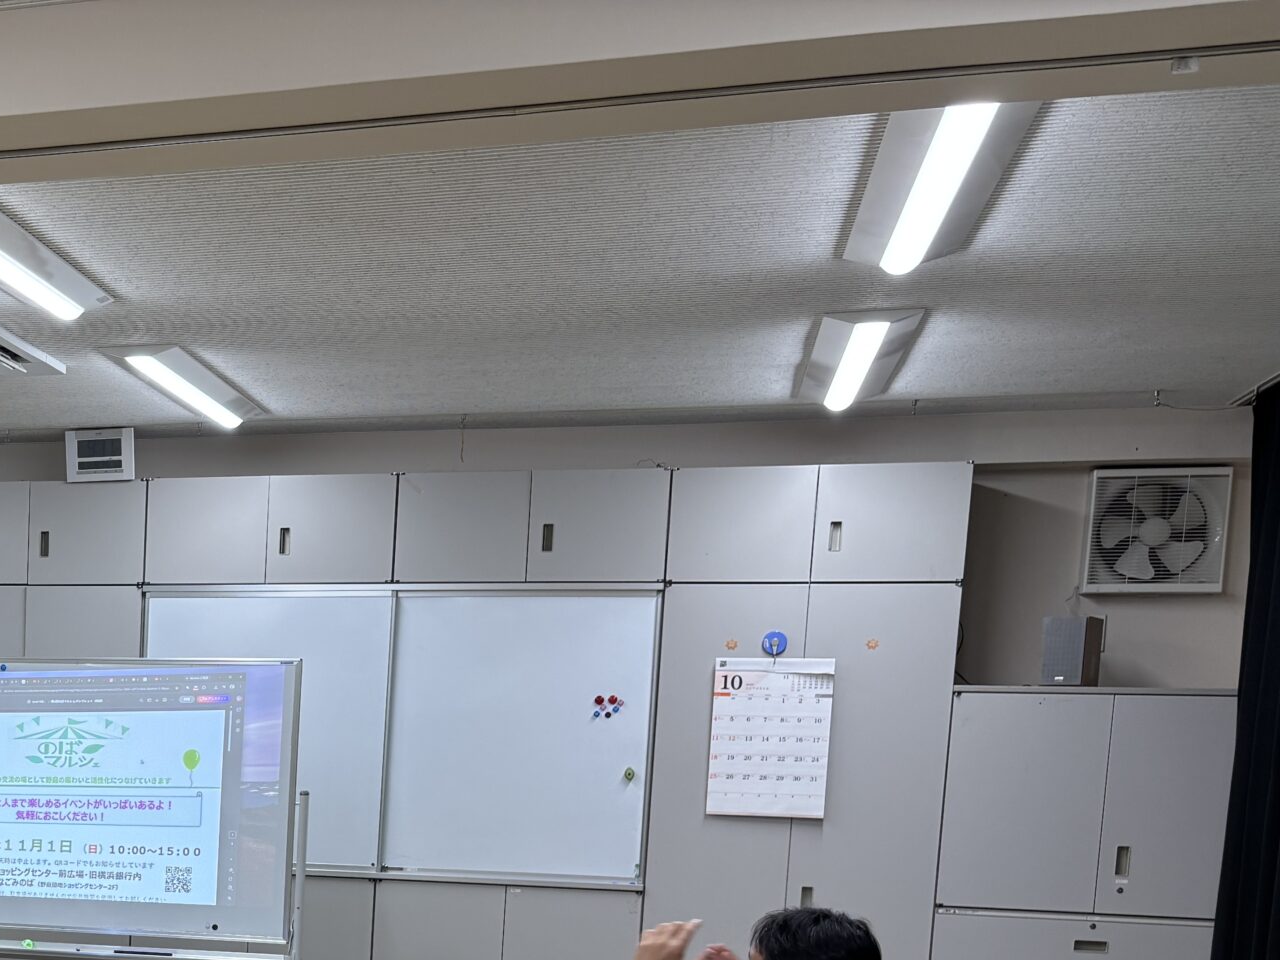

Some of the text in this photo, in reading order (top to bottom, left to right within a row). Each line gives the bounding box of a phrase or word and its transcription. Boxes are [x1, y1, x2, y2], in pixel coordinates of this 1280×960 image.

[720, 674, 743, 690] 10
[37, 740, 83, 755] のば
[43, 756, 101, 768] マルシェ
[15, 810, 104, 822] 気軽におこしください！
